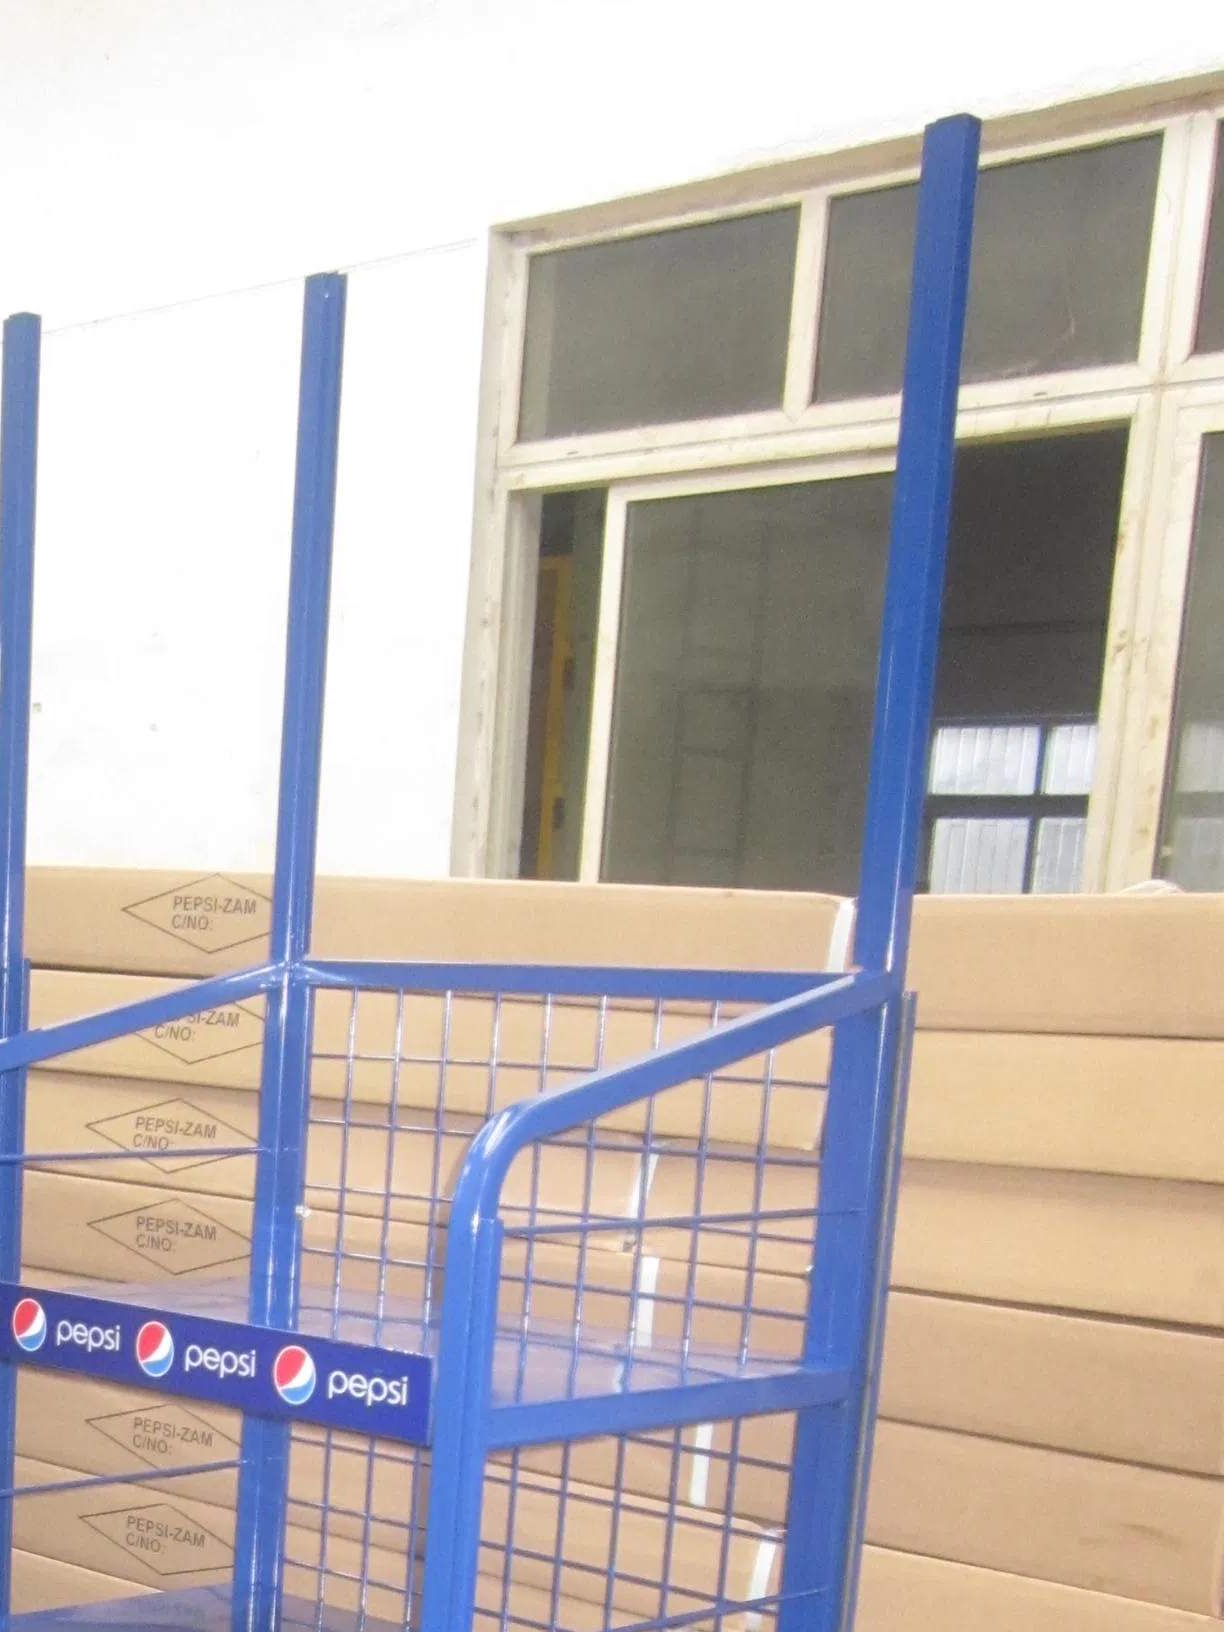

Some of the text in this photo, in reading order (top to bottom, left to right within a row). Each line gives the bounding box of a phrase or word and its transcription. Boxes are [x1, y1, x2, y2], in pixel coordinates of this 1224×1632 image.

[172, 895, 257, 915] PEPSI-ZAM
[136, 1116, 216, 1138] PEPSI-ZAM
[135, 1215, 217, 1241] PEPSI-ZAM
[56, 1318, 121, 1353] pepsi
[184, 1343, 257, 1379] pepsi
[327, 1369, 408, 1407] pepsi
[132, 1416, 214, 1448] PEPSI-ZAM
[126, 1515, 206, 1548] PEPSI-ZAM
